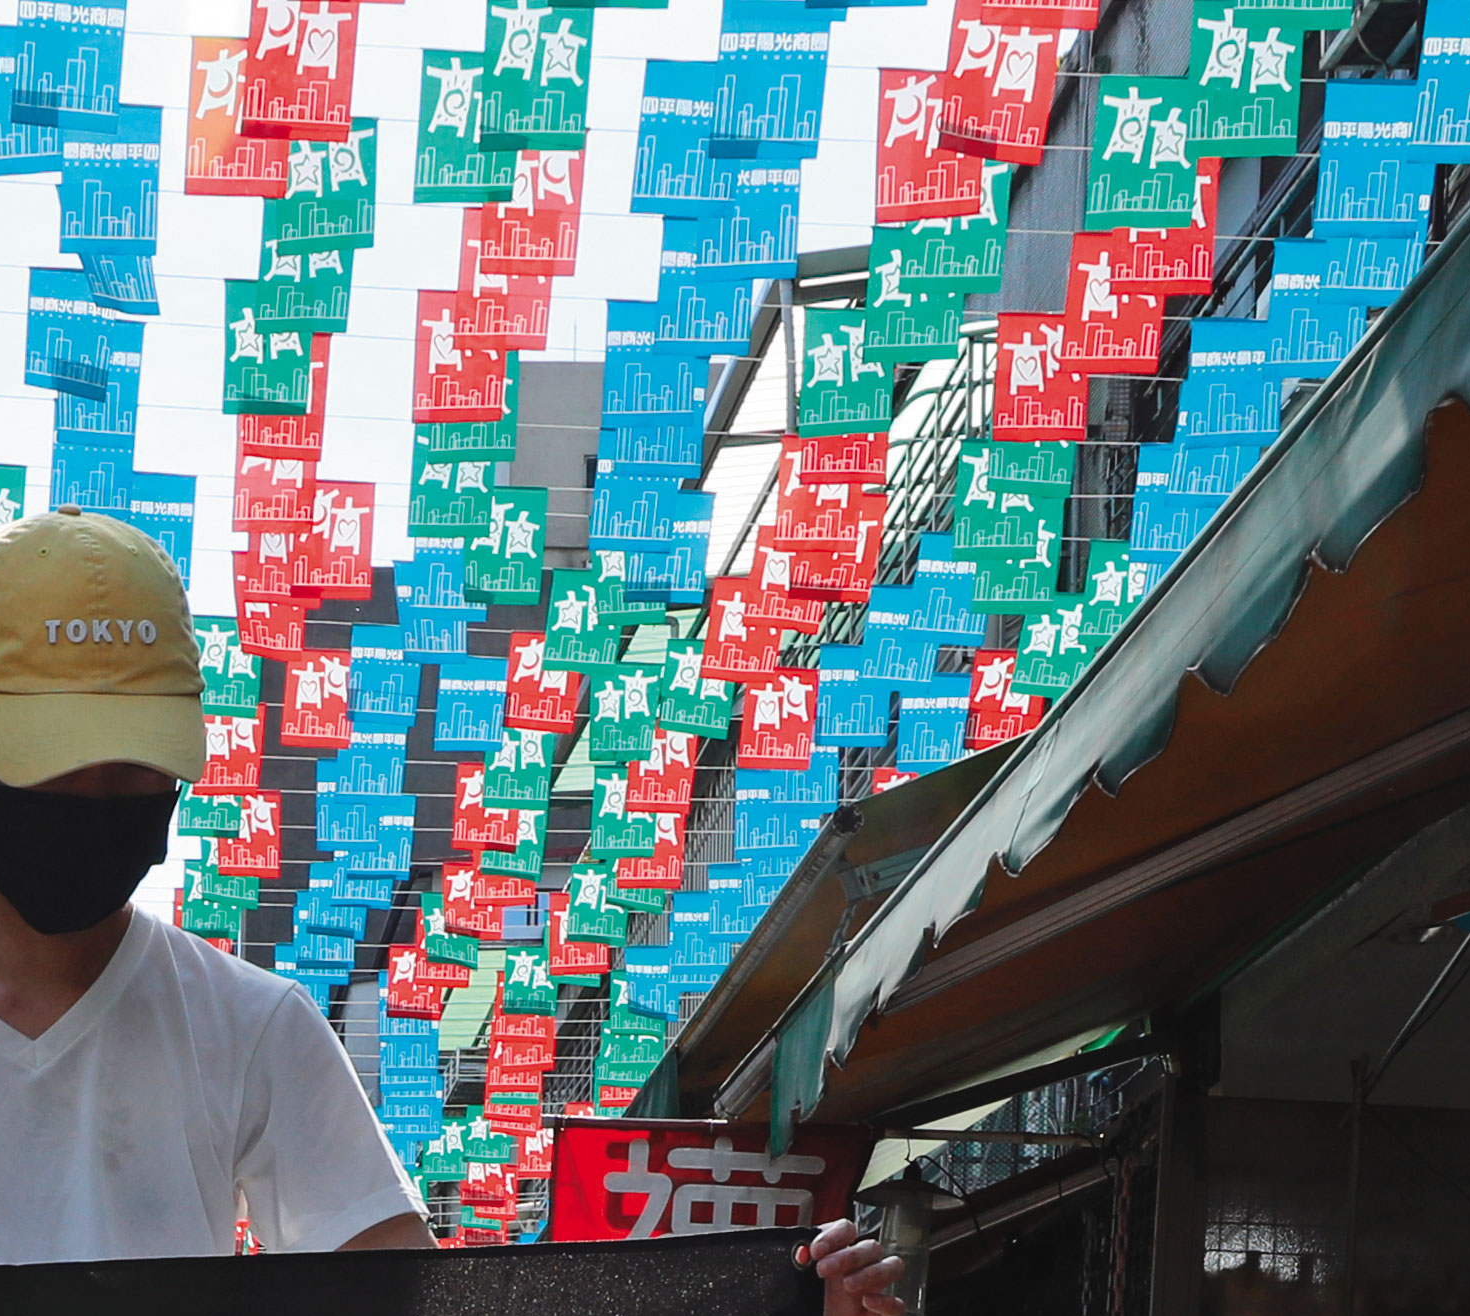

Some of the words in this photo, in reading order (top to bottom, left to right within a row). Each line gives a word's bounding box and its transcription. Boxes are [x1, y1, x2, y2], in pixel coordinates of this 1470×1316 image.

[720, 32, 829, 52] 四平陽光商圈
[44, 618, 158, 646] TOKYO
